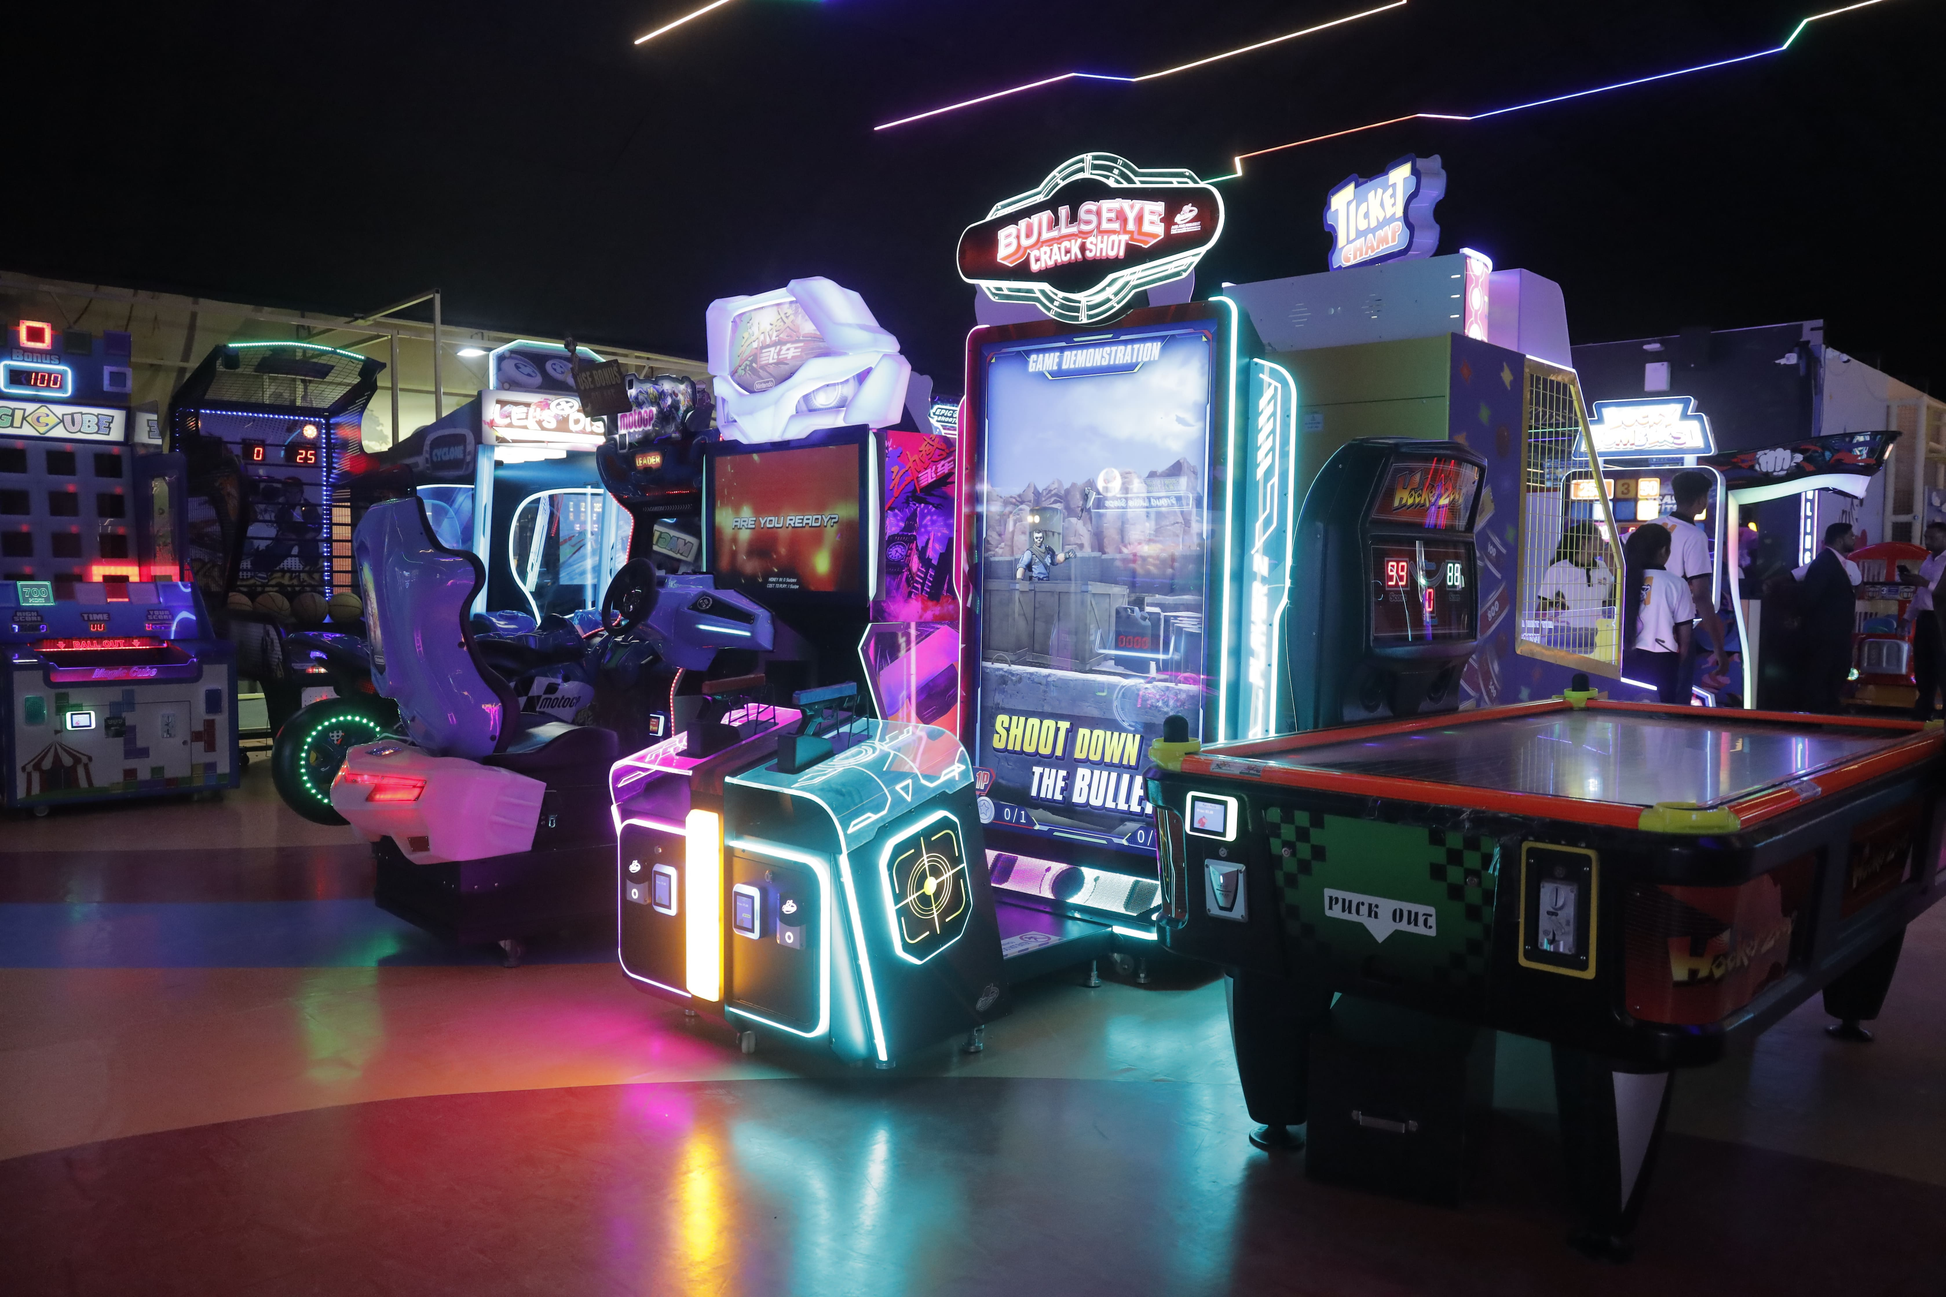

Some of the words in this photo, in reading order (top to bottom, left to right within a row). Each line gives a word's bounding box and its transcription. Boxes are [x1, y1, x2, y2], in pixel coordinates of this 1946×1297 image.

[1331, 161, 1412, 248] TICKET
[997, 198, 1165, 265] BULLSEYE
[1341, 221, 1403, 265] CHAMP
[1030, 238, 1083, 272] CRACK
[1086, 234, 1129, 261] SHOT
[12, 349, 60, 364] Bonus
[760, 342, 805, 364] 飞车
[1028, 351, 1060, 372] GAME
[1062, 342, 1162, 370] DEMONSTRATION
[30, 372, 62, 388] 100
[577, 371, 594, 390] USE
[592, 366, 622, 387] BONUS
[296, 449, 316, 463] 25
[635, 455, 661, 467] LEADER
[918, 456, 955, 487] 飞车
[1621, 482, 1630, 496] 3
[732, 517, 756, 529] ARE
[759, 516, 784, 528] YOU
[786, 514, 839, 528] READY?
[1387, 561, 1408, 585] 99
[1446, 563, 1461, 586] 88
[23, 588, 48, 597] 700
[73, 640, 99, 649] BALL
[103, 640, 125, 648] OUT
[1249, 579, 1268, 690] PLAYER
[992, 714, 1072, 759] SHOOT
[1073, 727, 1143, 767] DOWN
[976, 770, 990, 790] 1P
[1030, 766, 1069, 802] THE
[1072, 767, 1153, 817] BULLE
[1328, 895, 1380, 919] PUCK
[1392, 907, 1434, 930] OUT
